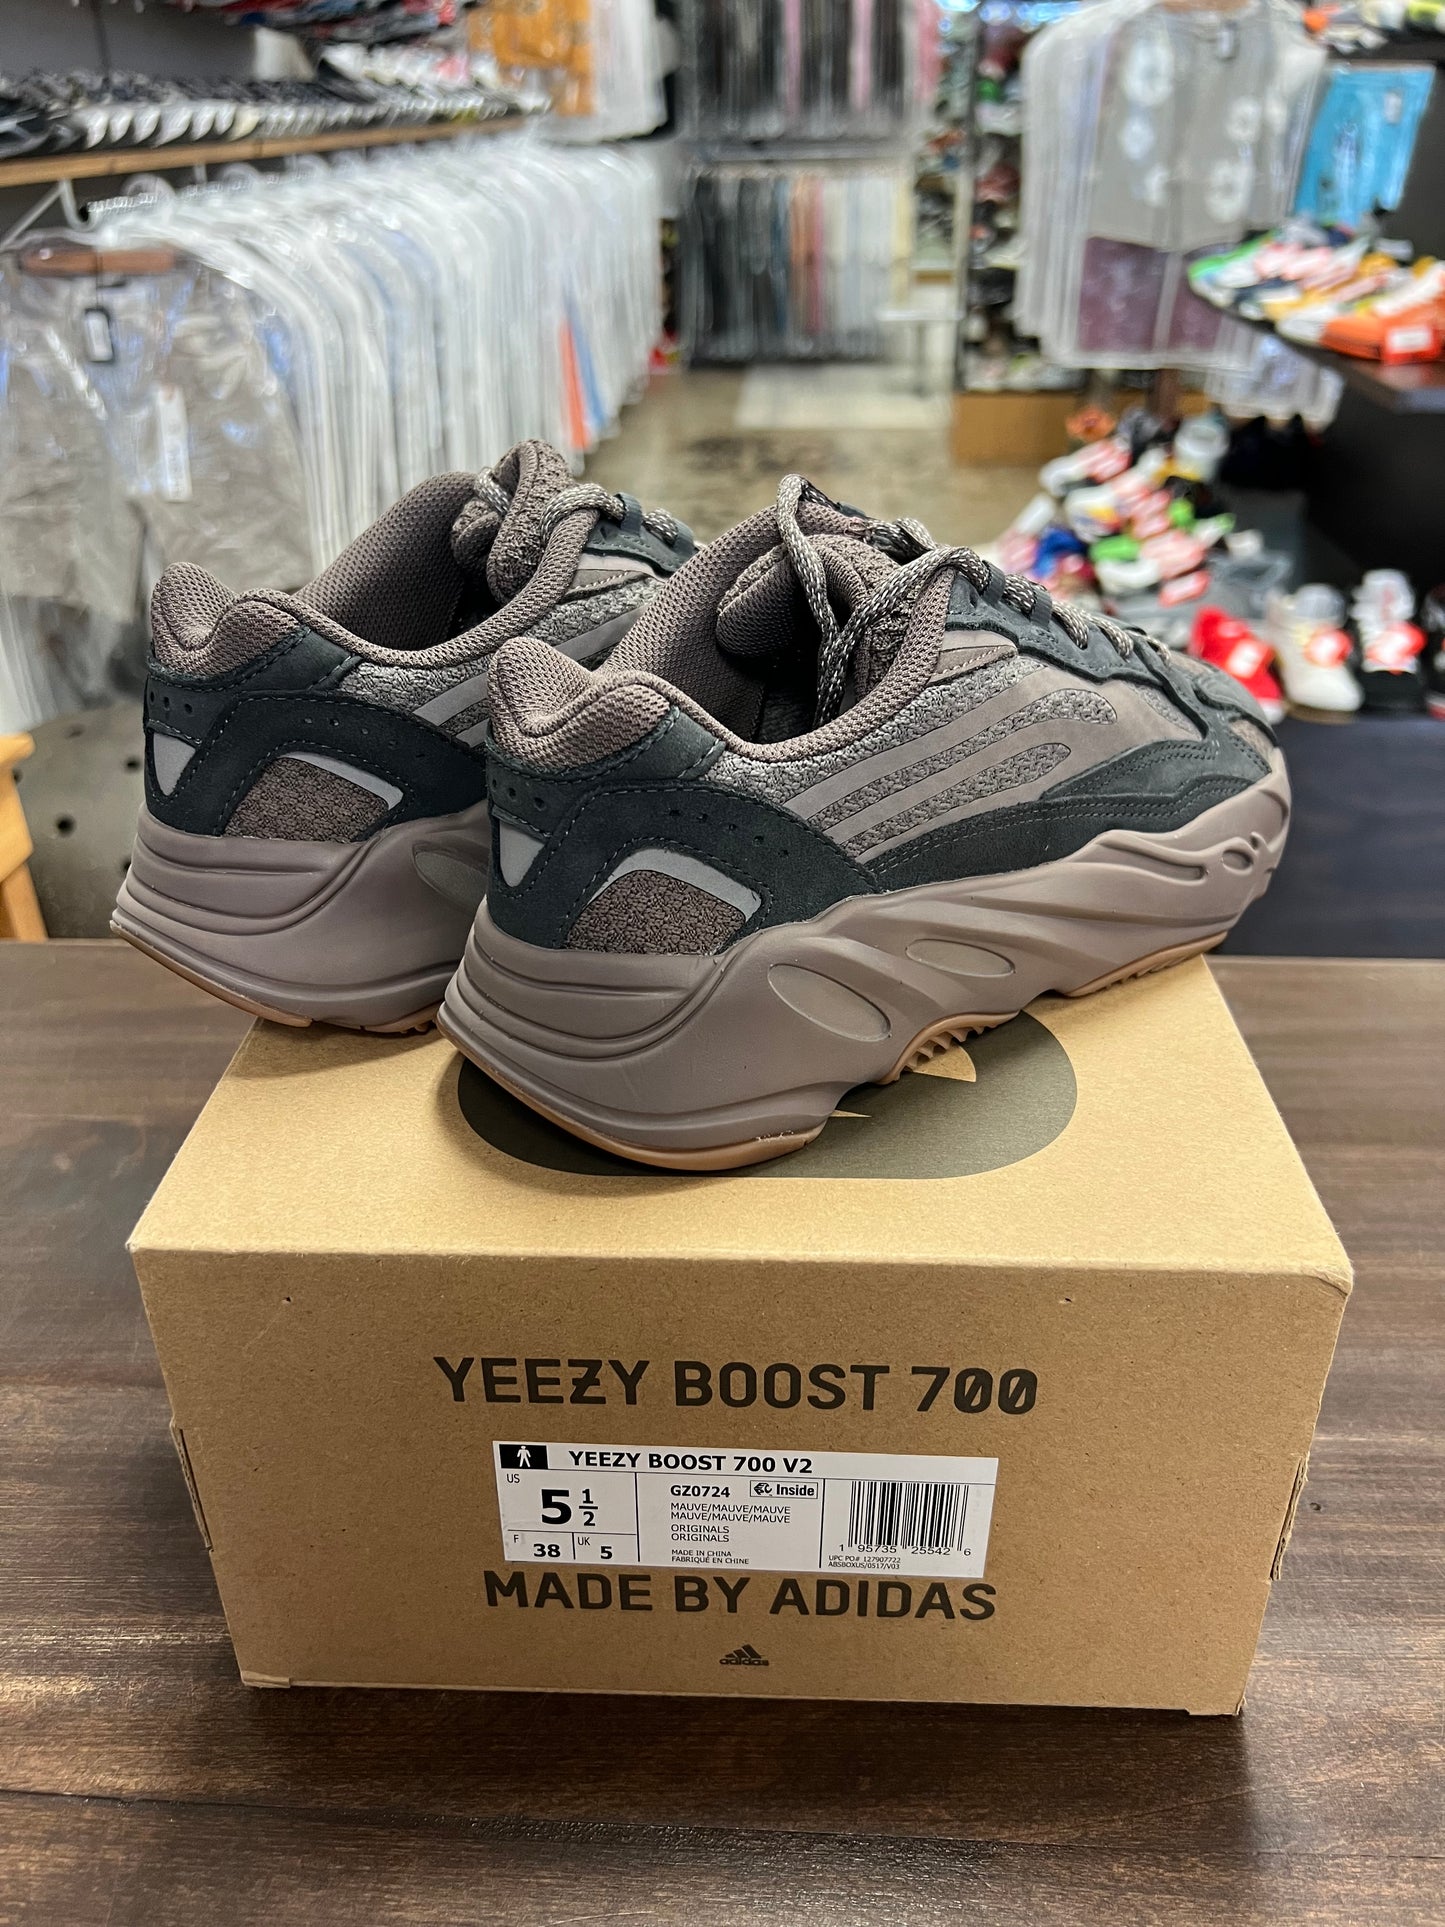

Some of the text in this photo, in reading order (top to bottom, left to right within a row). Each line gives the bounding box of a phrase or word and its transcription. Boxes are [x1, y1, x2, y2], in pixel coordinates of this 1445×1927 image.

[433, 1356, 1038, 1415] YEEZY BOOST 700
[568, 1450, 813, 1474] YEEZY BOOST 700 V2
[506, 1473, 520, 1484] US
[670, 1484, 730, 1498] GZ0724
[776, 1483, 815, 1496] Inside
[540, 1488, 572, 1525] 5
[670, 1502, 792, 1514] MAUVE/MAUVE/MAUVE
[670, 1511, 791, 1523] MAUVE/MAUVE/MAUVE
[671, 1524, 730, 1534] ORIGINALS
[513, 1534, 519, 1543] F
[577, 1536, 591, 1546] UK
[671, 1533, 730, 1543] ORIGINALS
[533, 1543, 561, 1558] 38
[600, 1545, 613, 1560] 5
[857, 1544, 897, 1554] 95735
[911, 1546, 951, 1556] 25542
[963, 1548, 972, 1557] 6
[484, 1570, 997, 1621] MADE BY ADIDAS
[719, 1656, 769, 1666] adidas
